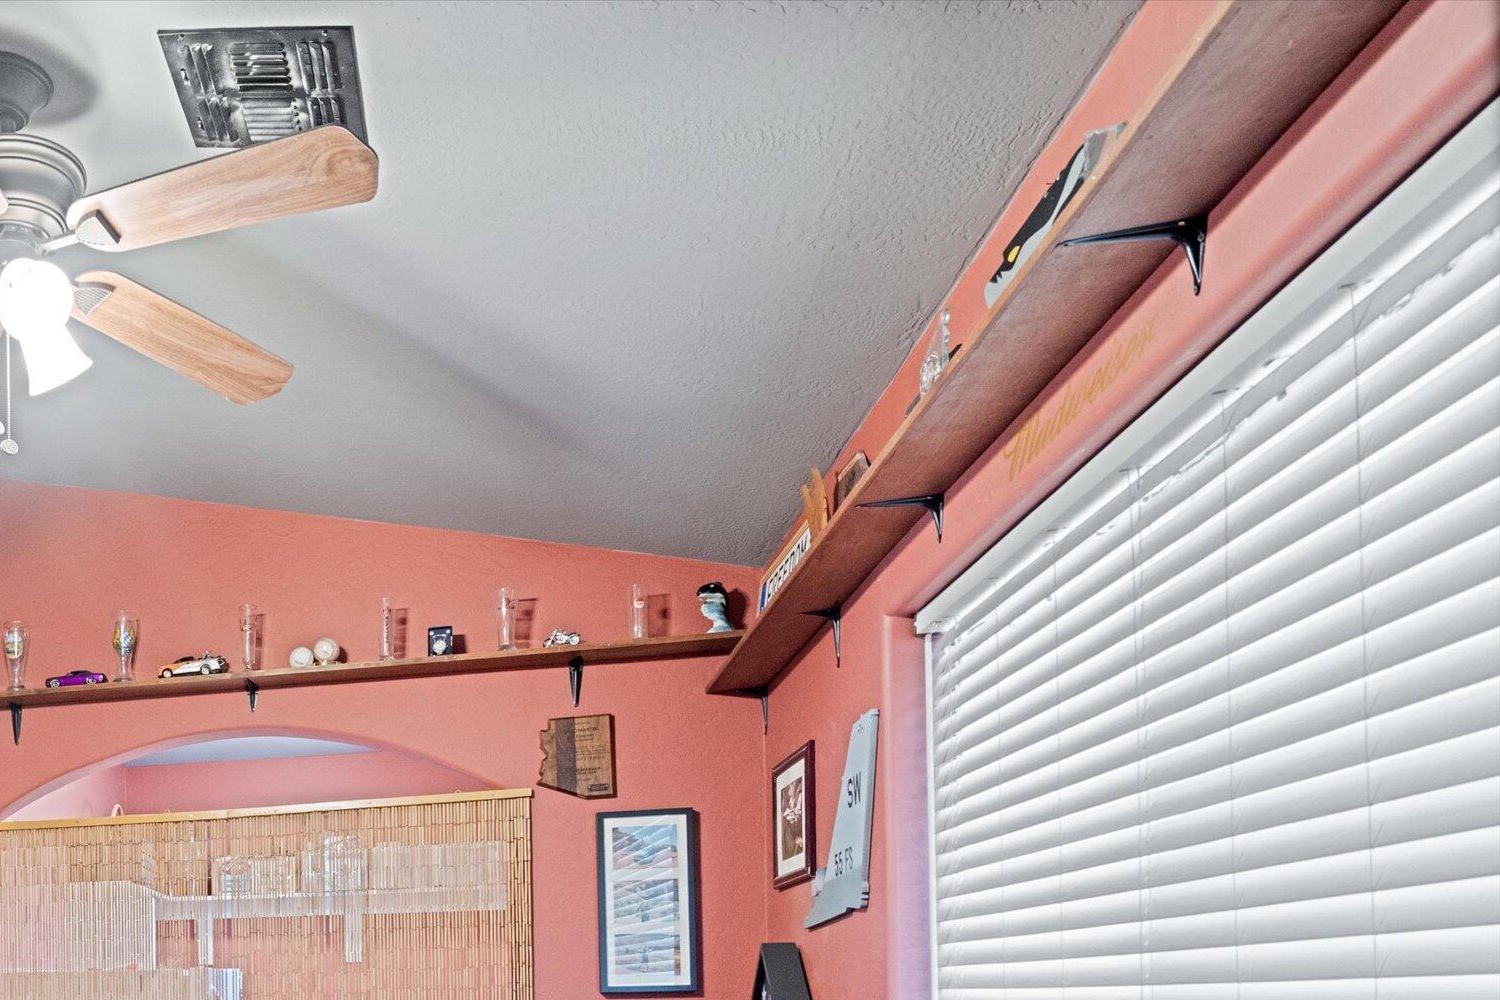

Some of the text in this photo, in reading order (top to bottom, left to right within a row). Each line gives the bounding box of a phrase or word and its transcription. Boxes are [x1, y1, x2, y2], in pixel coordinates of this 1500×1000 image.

[847, 771, 862, 808] SW
[834, 846, 853, 877] 55 FS
